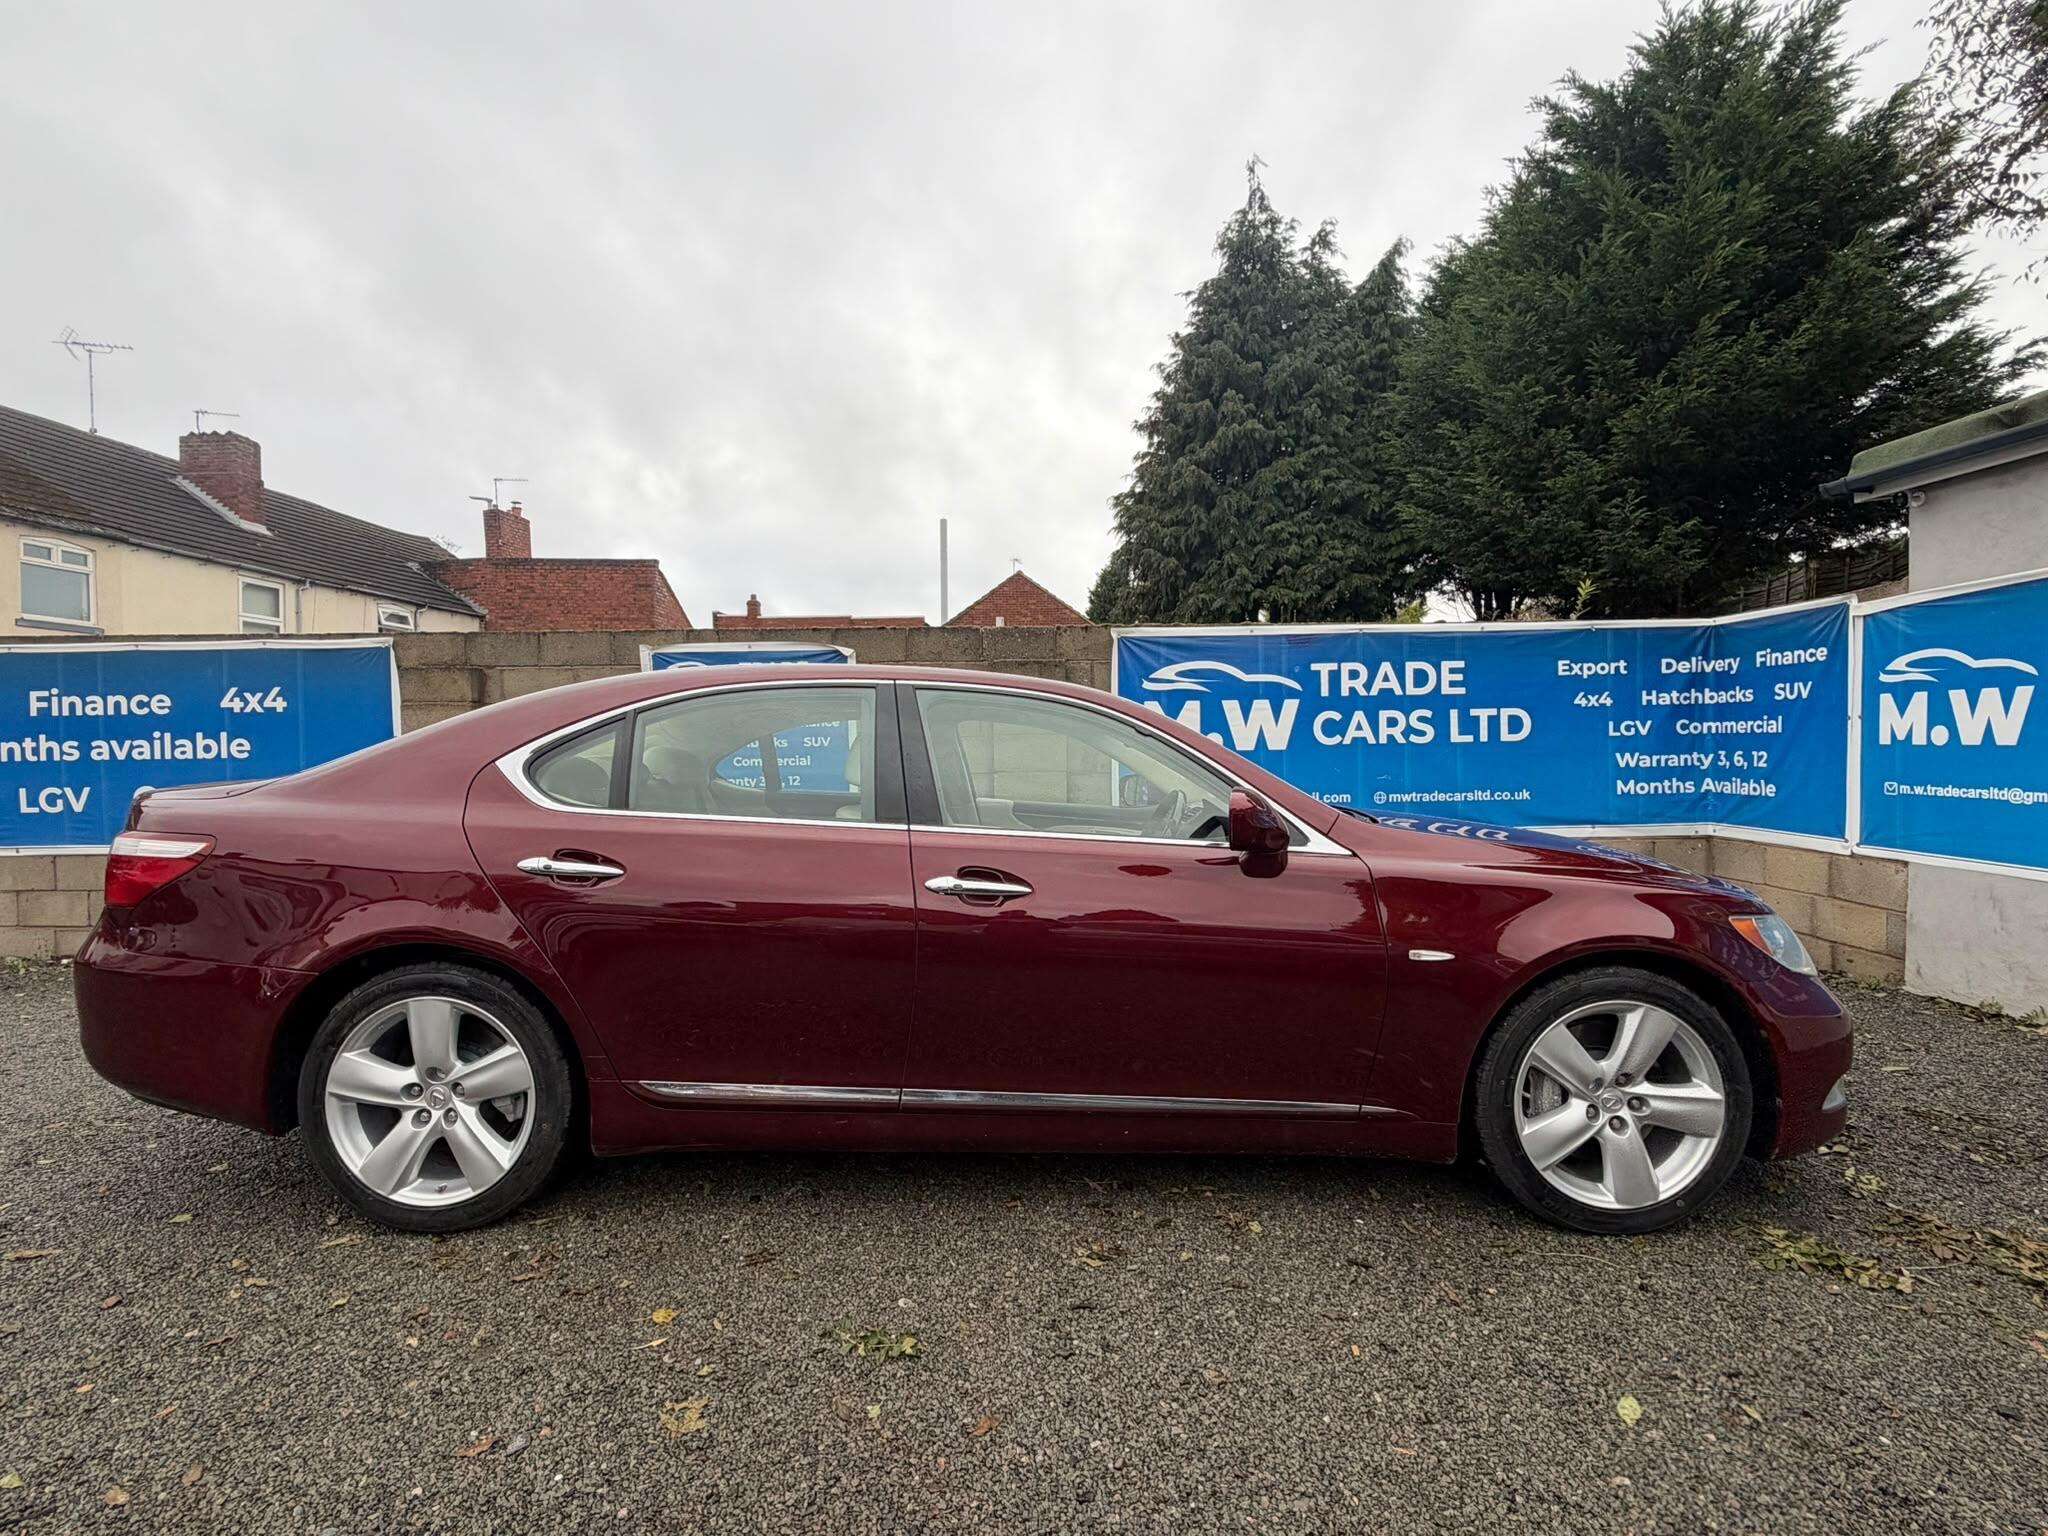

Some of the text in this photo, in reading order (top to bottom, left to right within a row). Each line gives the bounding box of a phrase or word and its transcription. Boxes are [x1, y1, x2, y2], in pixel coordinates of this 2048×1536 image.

[1557, 646, 1828, 679] Export Delivery Finance
[1310, 660, 1466, 698] TRADE
[28, 686, 288, 717] Finance 4x4
[1573, 681, 1813, 708] 4x4 Hatchbacks SUV
[1312, 707, 1532, 745] CARS LTD
[1608, 715, 1783, 737] LGV Commercial
[1879, 685, 2036, 747] M.W
[90, 731, 252, 761] available
[803, 736, 831, 747] SUV
[733, 755, 811, 767] Comercial
[1615, 750, 1768, 770] Warranty 3, 6, 12
[18, 786, 91, 814] LGV
[1388, 788, 1532, 803] mwtradecarsltd.co.uk
[1616, 777, 1777, 798] Months Available
